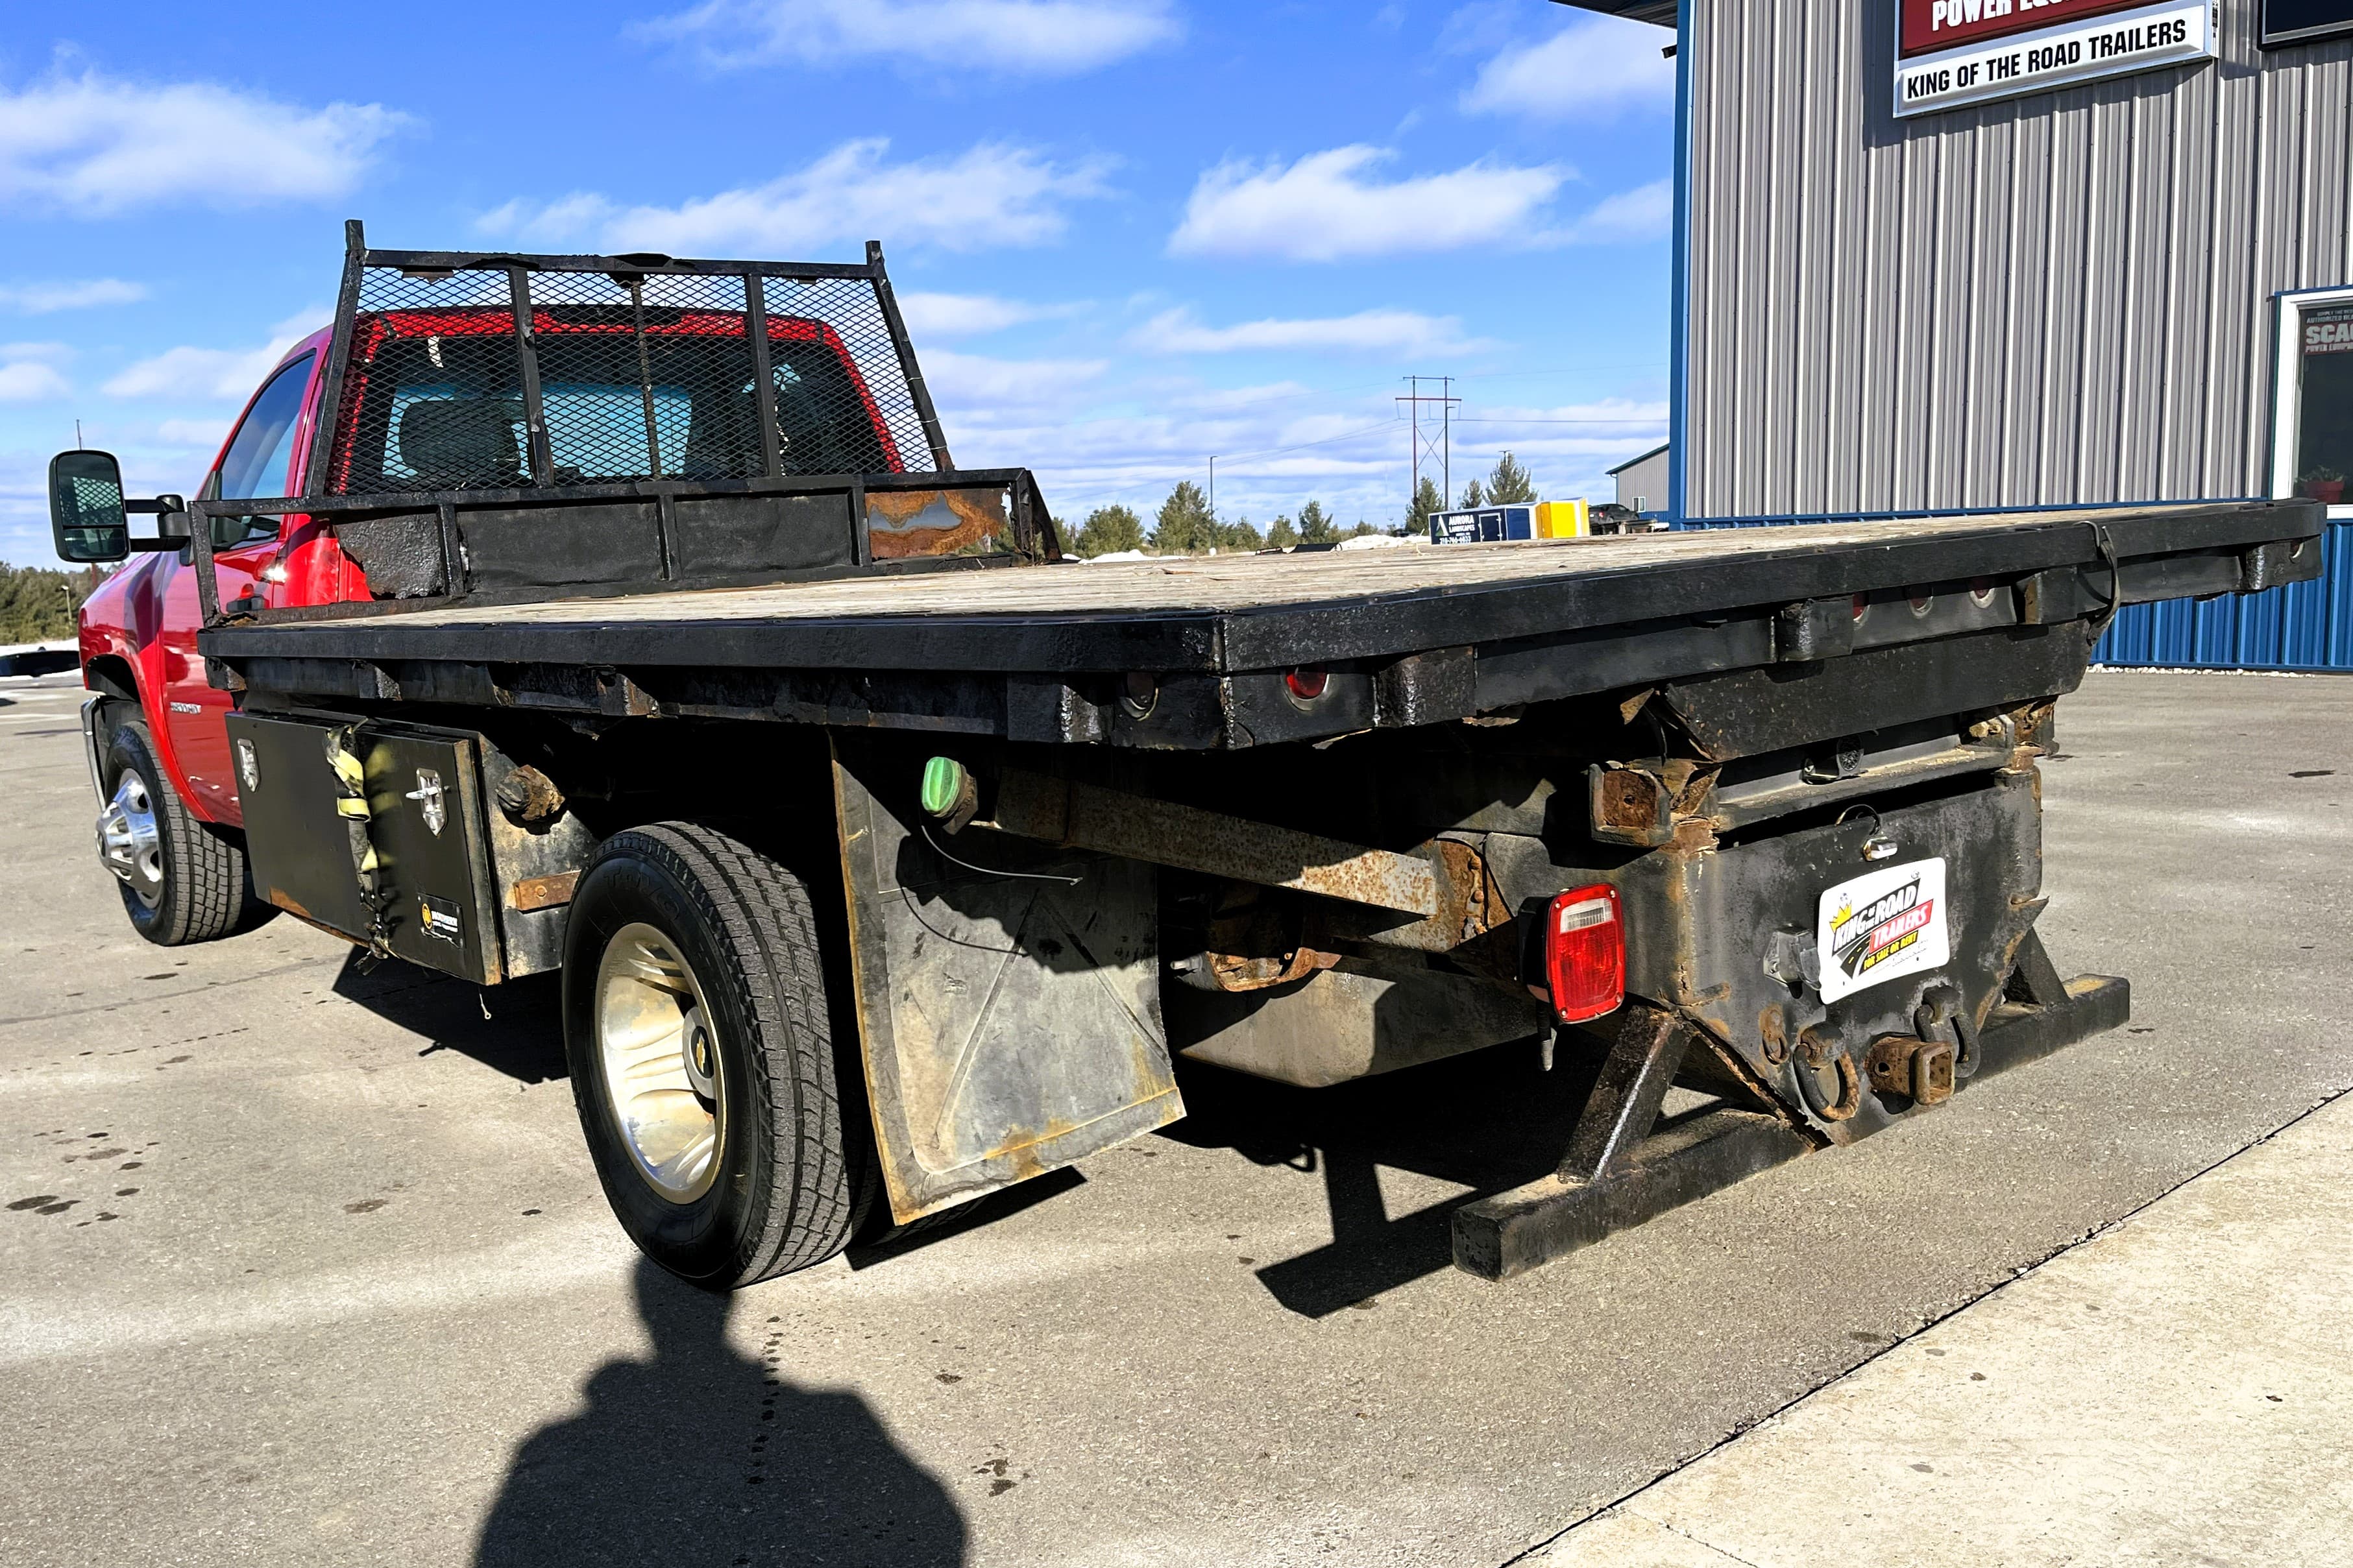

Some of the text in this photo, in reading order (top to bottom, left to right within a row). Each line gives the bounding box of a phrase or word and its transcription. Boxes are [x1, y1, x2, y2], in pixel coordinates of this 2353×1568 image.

[1932, 0, 2012, 31] POWER
[1907, 19, 2186, 99] KING OF THE ROAD TRAILERS
[2306, 323, 2353, 344] SCA
[1449, 514, 1474, 525] AURORA
[1833, 909, 1868, 952] KING
[1875, 885, 1917, 926] ROAD
[1873, 905, 1929, 948] TRAILERS
[1863, 956, 1875, 971] FOR
[1875, 947, 1890, 963] SALE
[1890, 942, 1900, 954] OR
[1900, 931, 1918, 948] RENT
